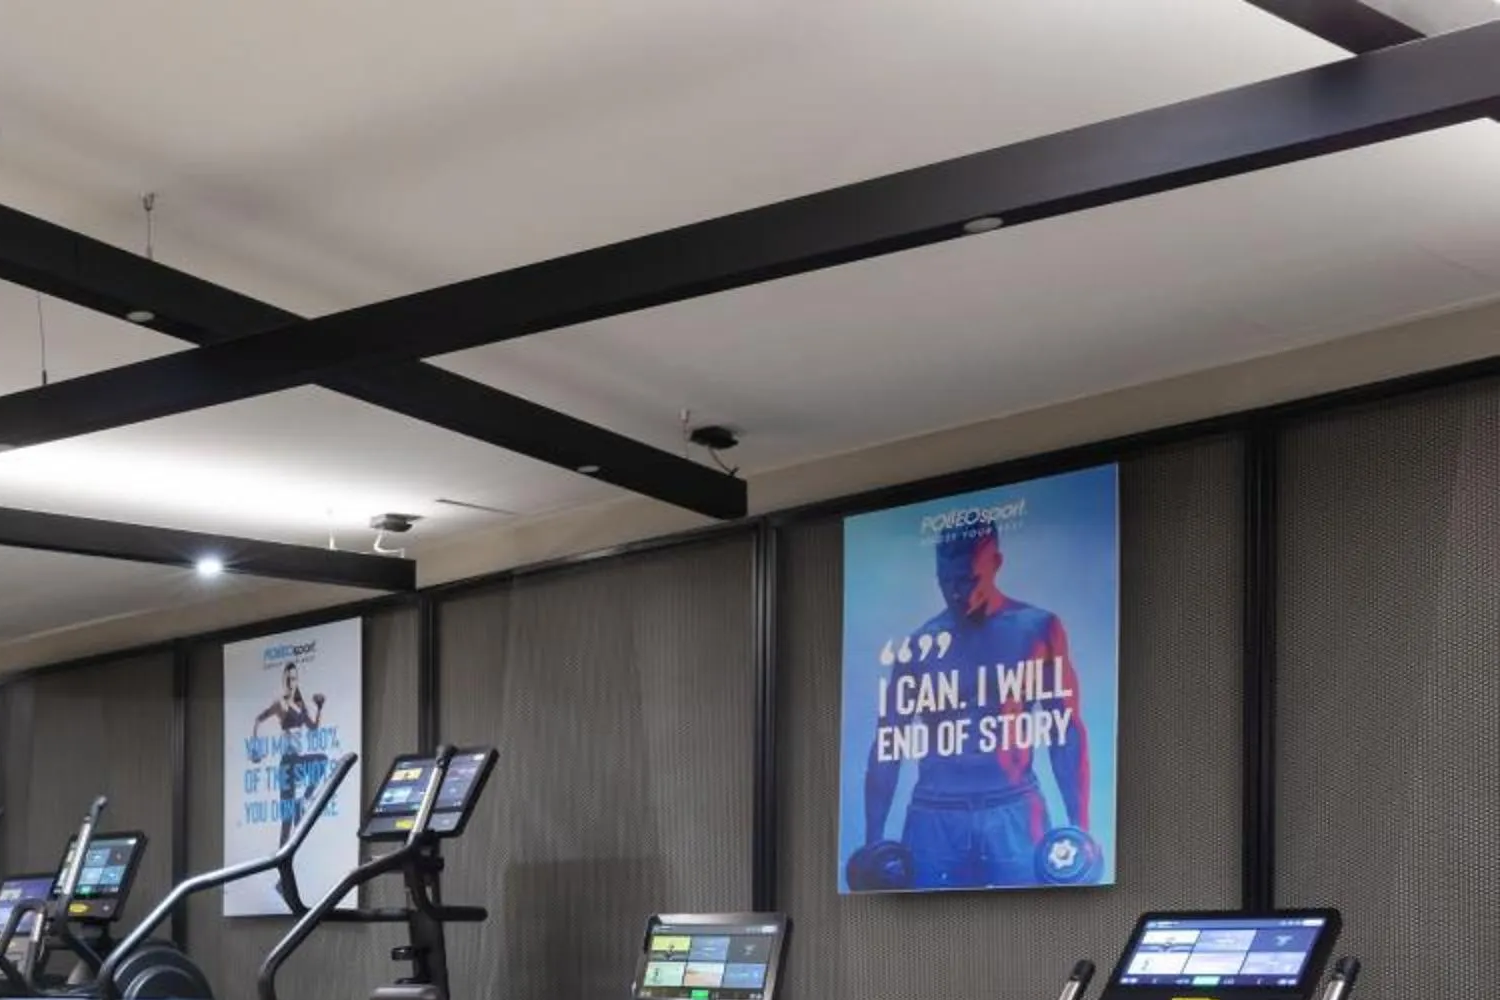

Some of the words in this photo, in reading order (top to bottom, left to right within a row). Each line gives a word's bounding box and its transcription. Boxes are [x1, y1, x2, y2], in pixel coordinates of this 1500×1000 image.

[878, 677, 888, 718] I
[896, 669, 967, 716] CAN.
[977, 665, 987, 708] I
[996, 656, 1074, 704] WILL
[243, 735, 269, 757] YOU
[877, 724, 930, 762] END
[937, 717, 972, 757] OF
[979, 708, 1073, 753] STORY
[244, 766, 261, 794] OF
[244, 799, 268, 823] YOU
